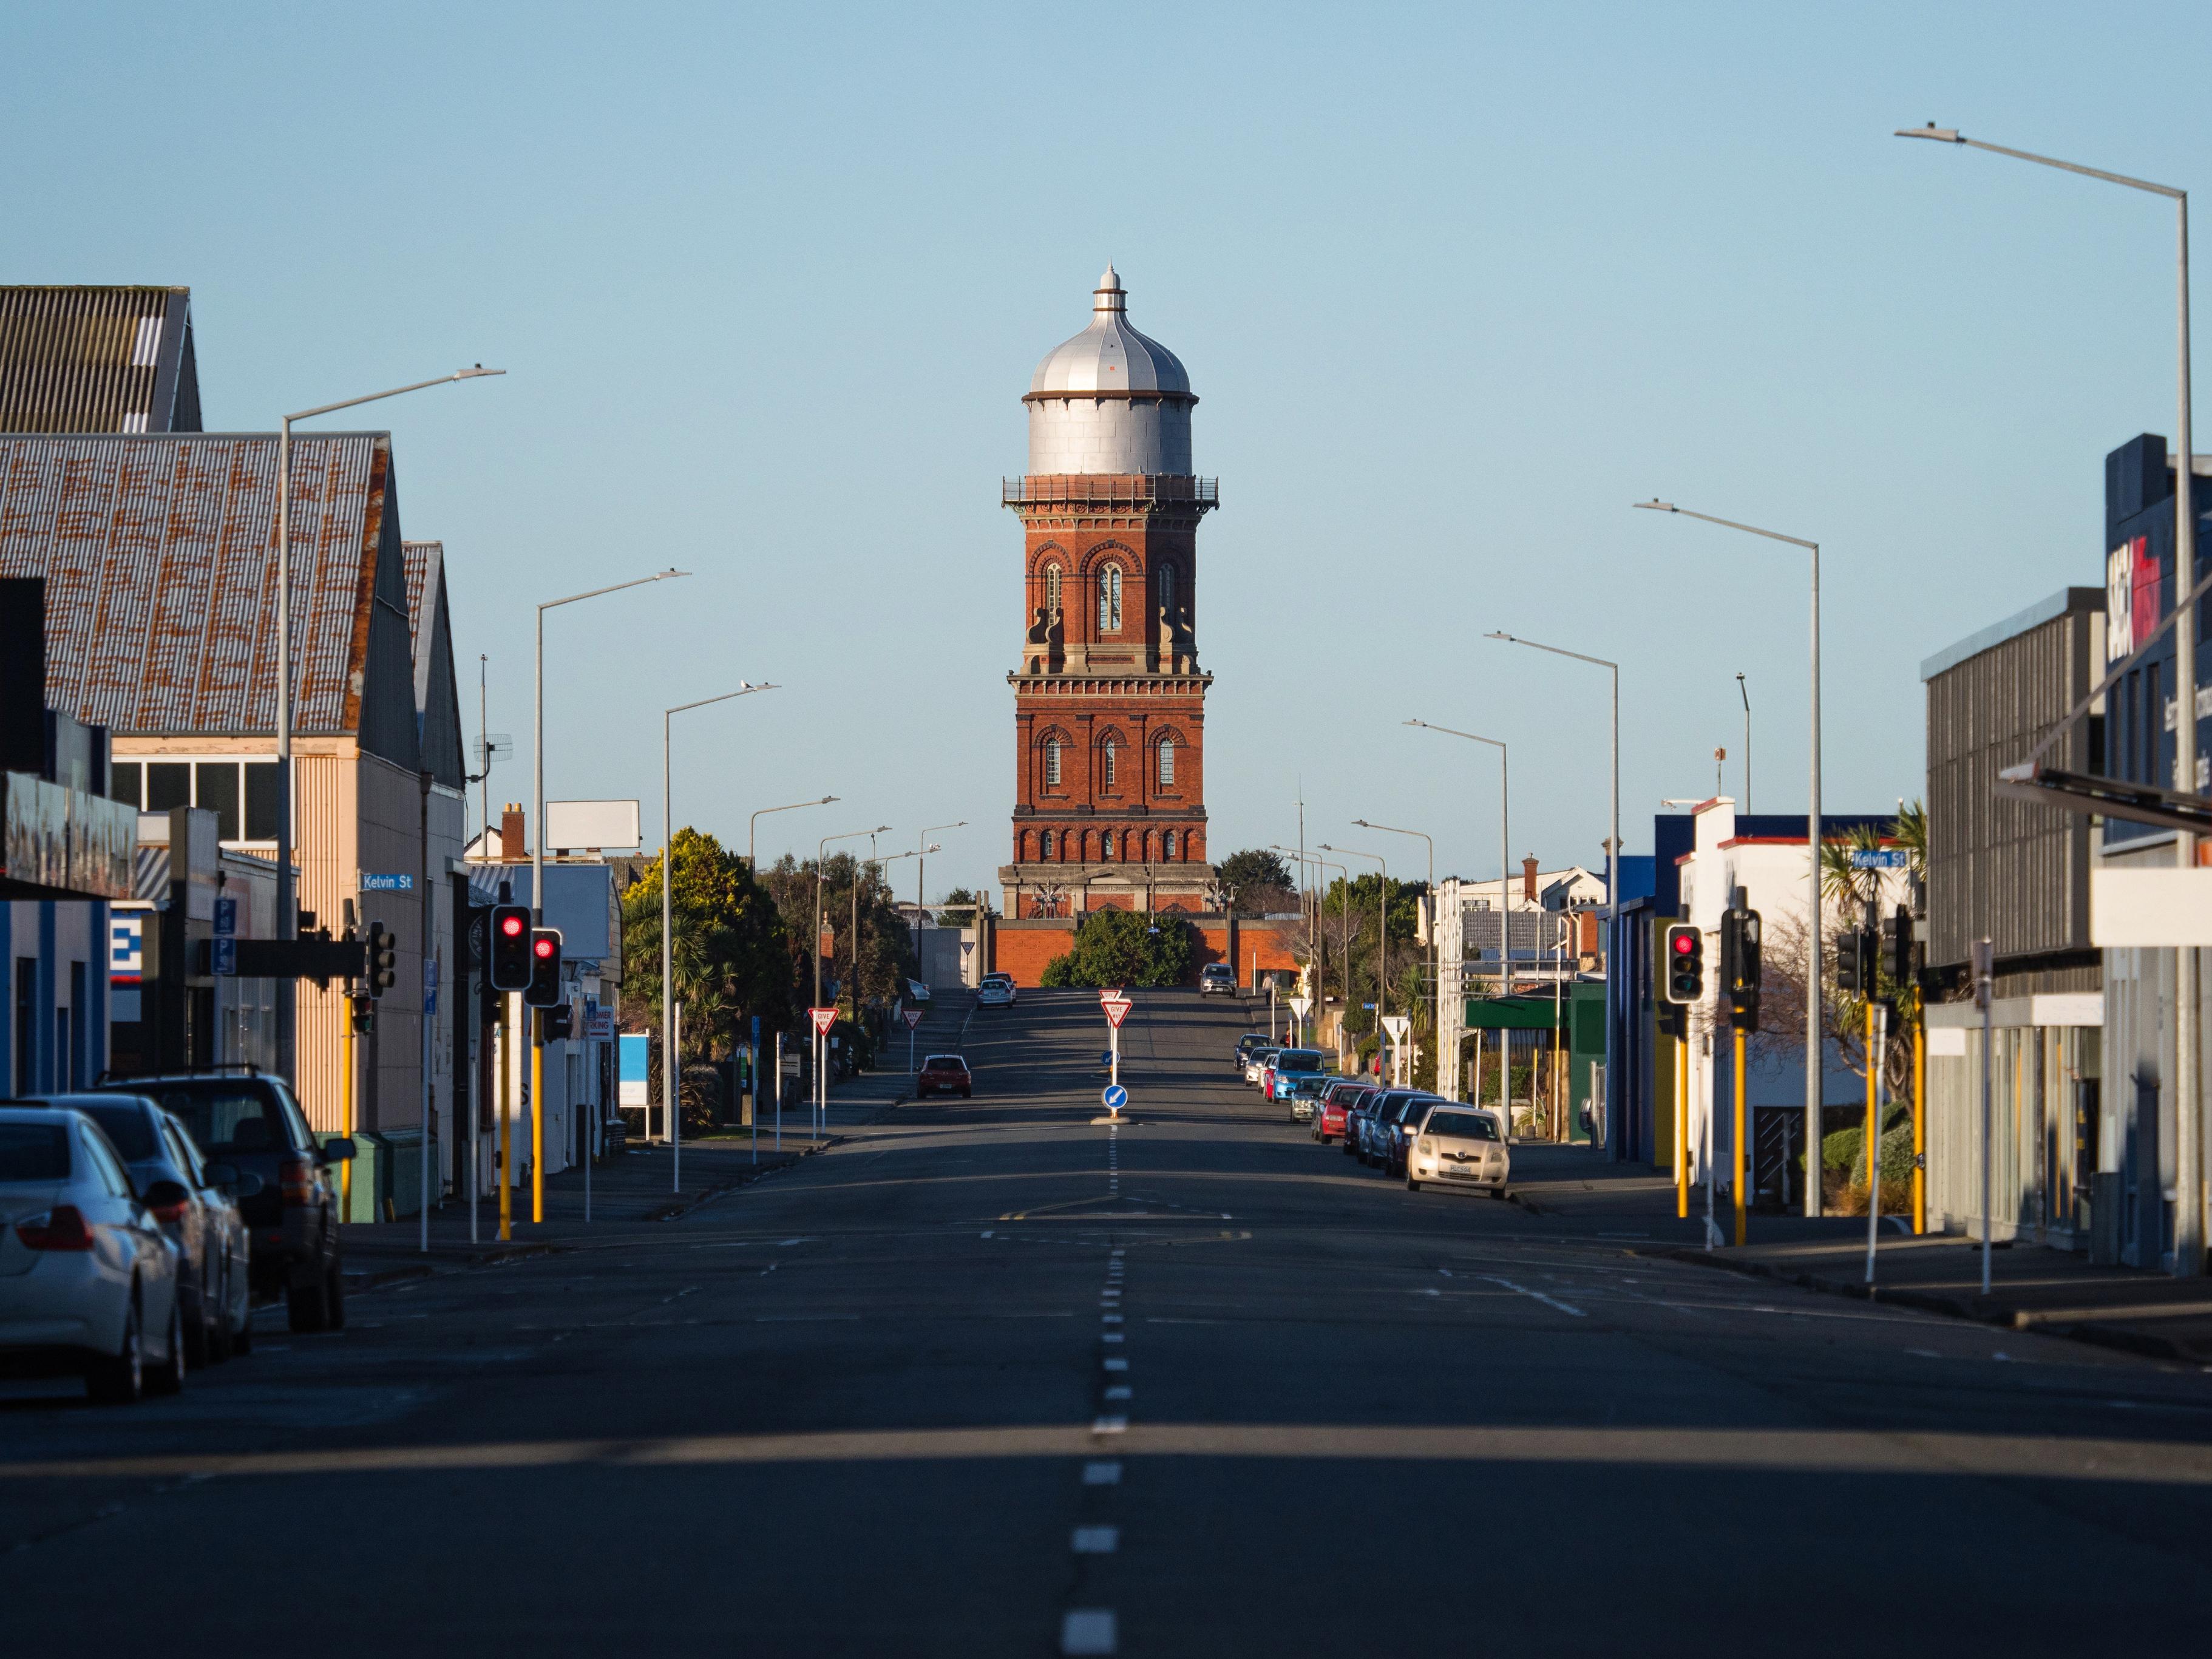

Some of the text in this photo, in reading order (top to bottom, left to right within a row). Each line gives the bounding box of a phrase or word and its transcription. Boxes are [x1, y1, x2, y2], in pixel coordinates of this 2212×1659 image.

[1854, 852, 1905, 866] Kelvin St
[364, 875, 412, 888] Kelvin St
